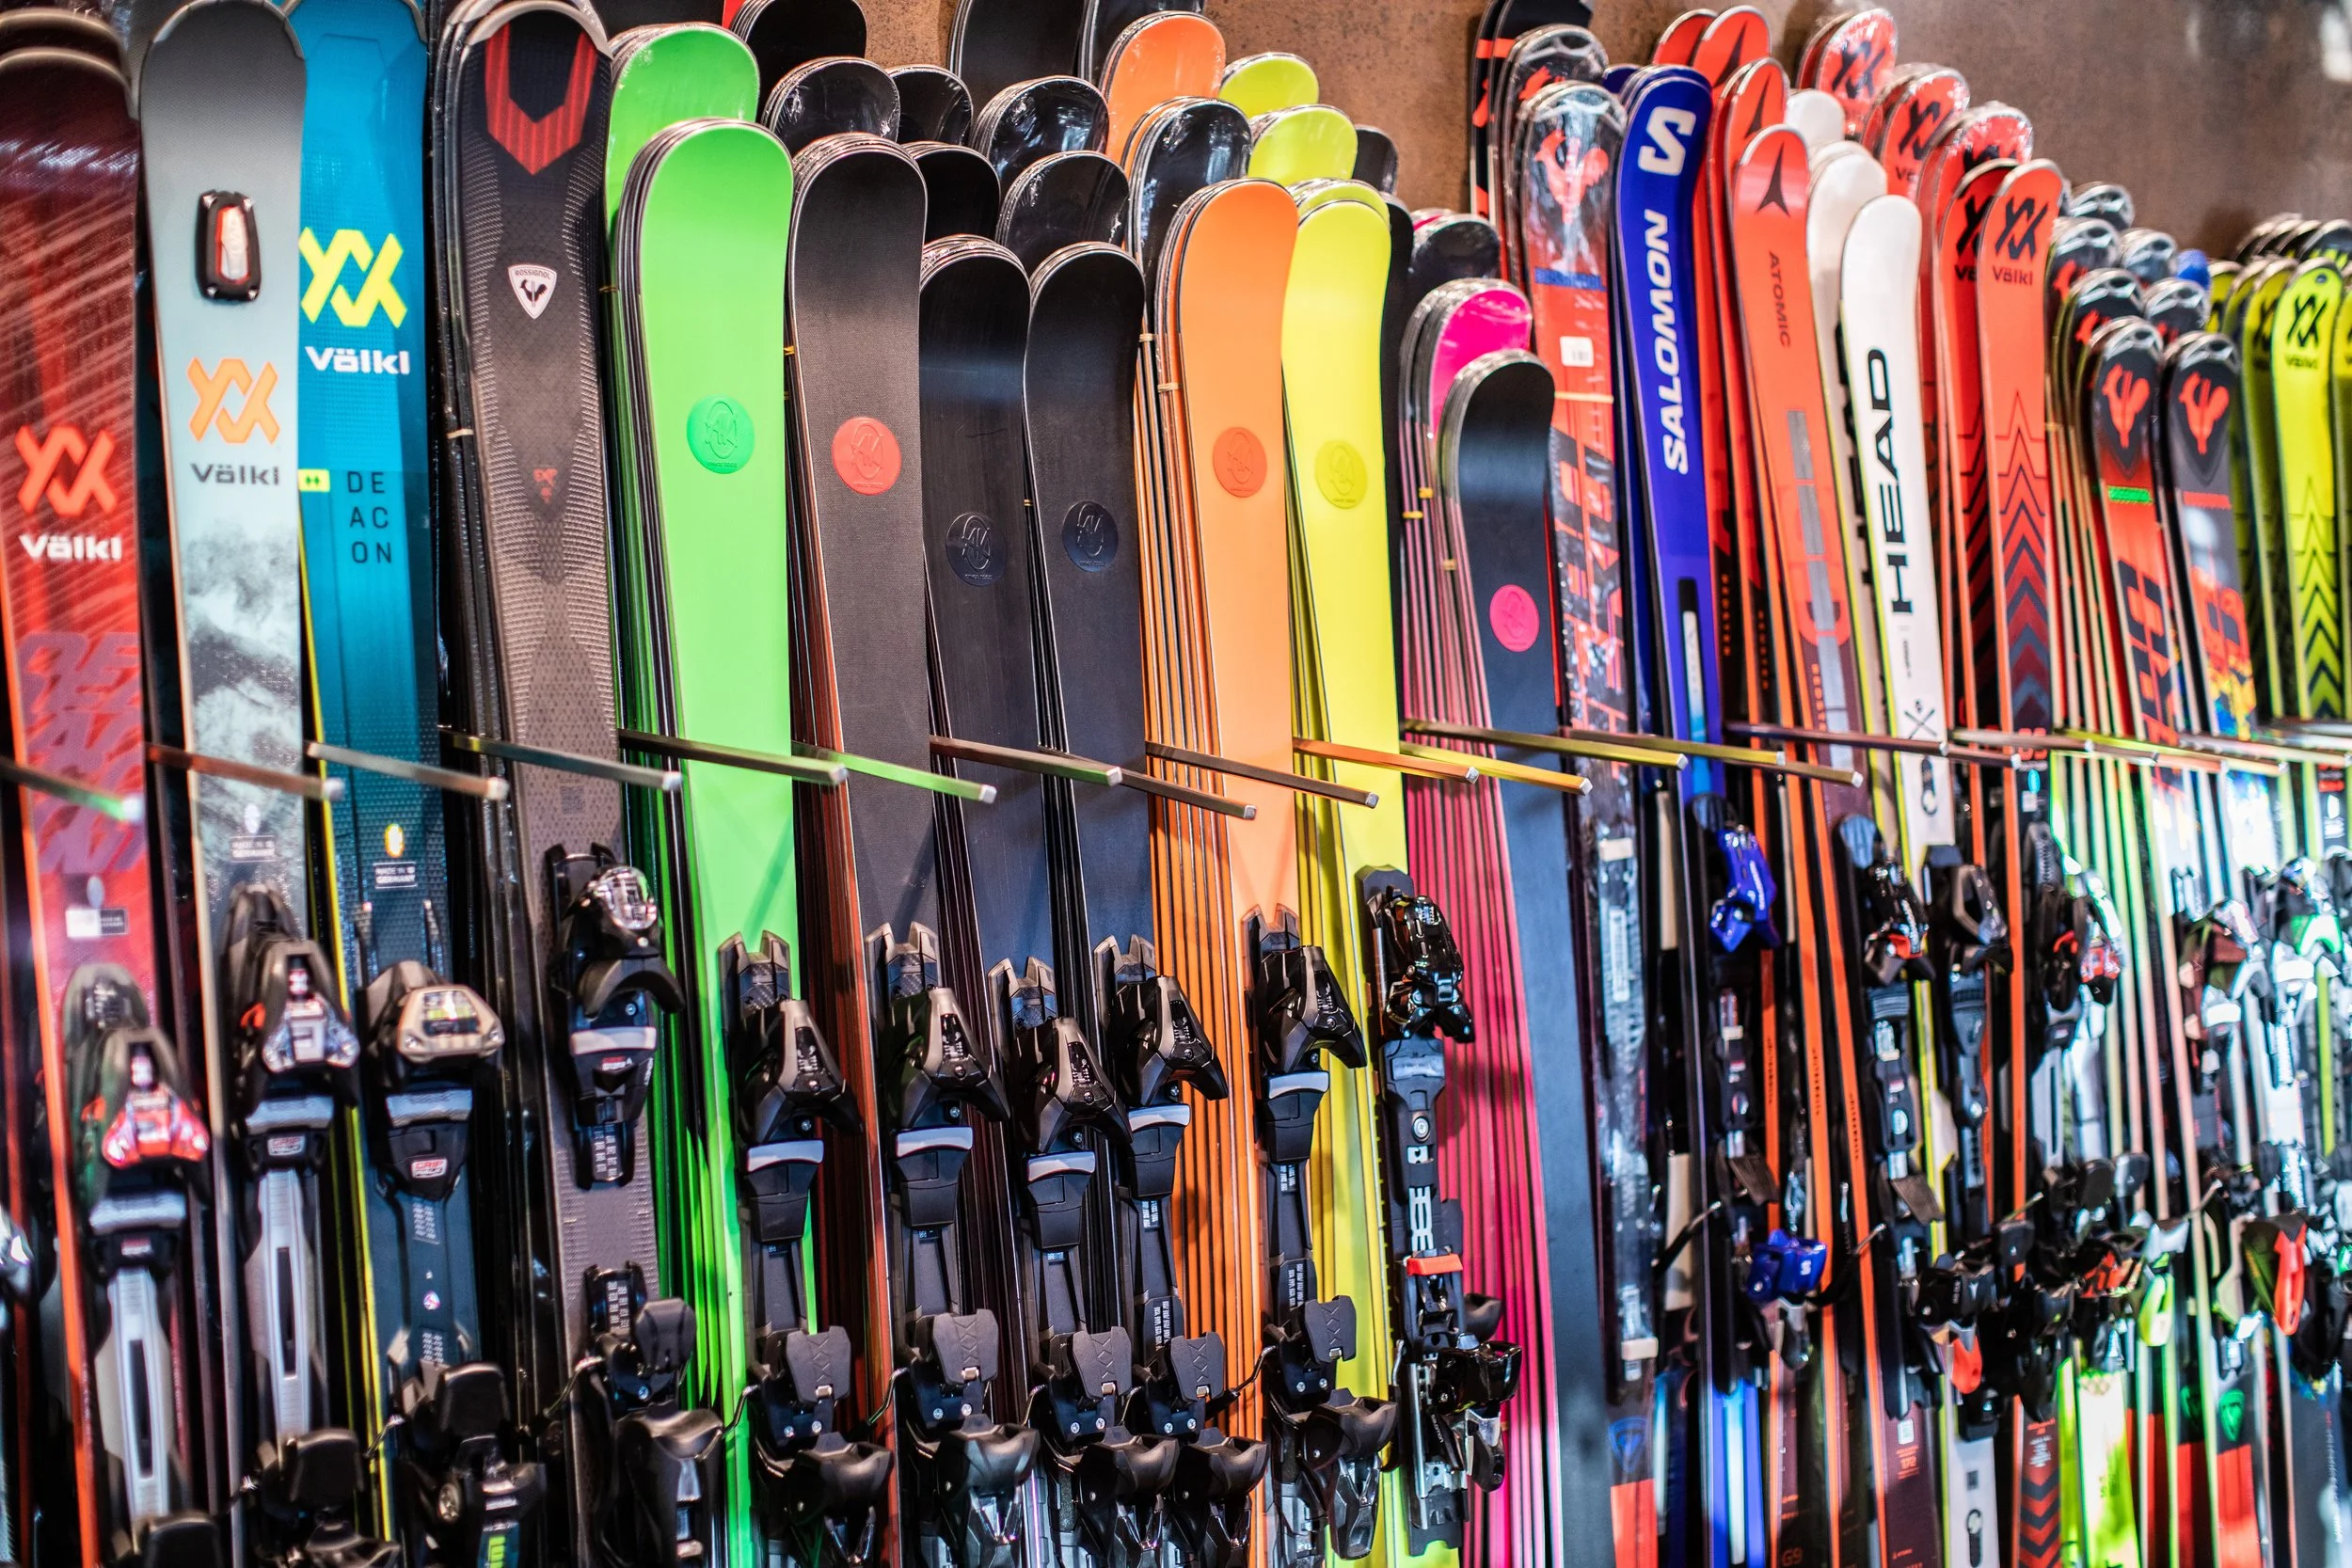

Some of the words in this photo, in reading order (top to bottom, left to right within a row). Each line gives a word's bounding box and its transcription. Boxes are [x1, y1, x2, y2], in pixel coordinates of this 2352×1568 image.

[515, 269, 550, 279] ROSSIGNOL
[1993, 265, 2033, 287] Völkl
[1769, 249, 1791, 348] ATOMIC
[1644, 209, 1688, 475] SALOMON
[304, 346, 410, 375] Völkl
[190, 458, 278, 486] Völkl
[1867, 348, 1914, 615] HEAD
[19, 533, 122, 562] Völkl
